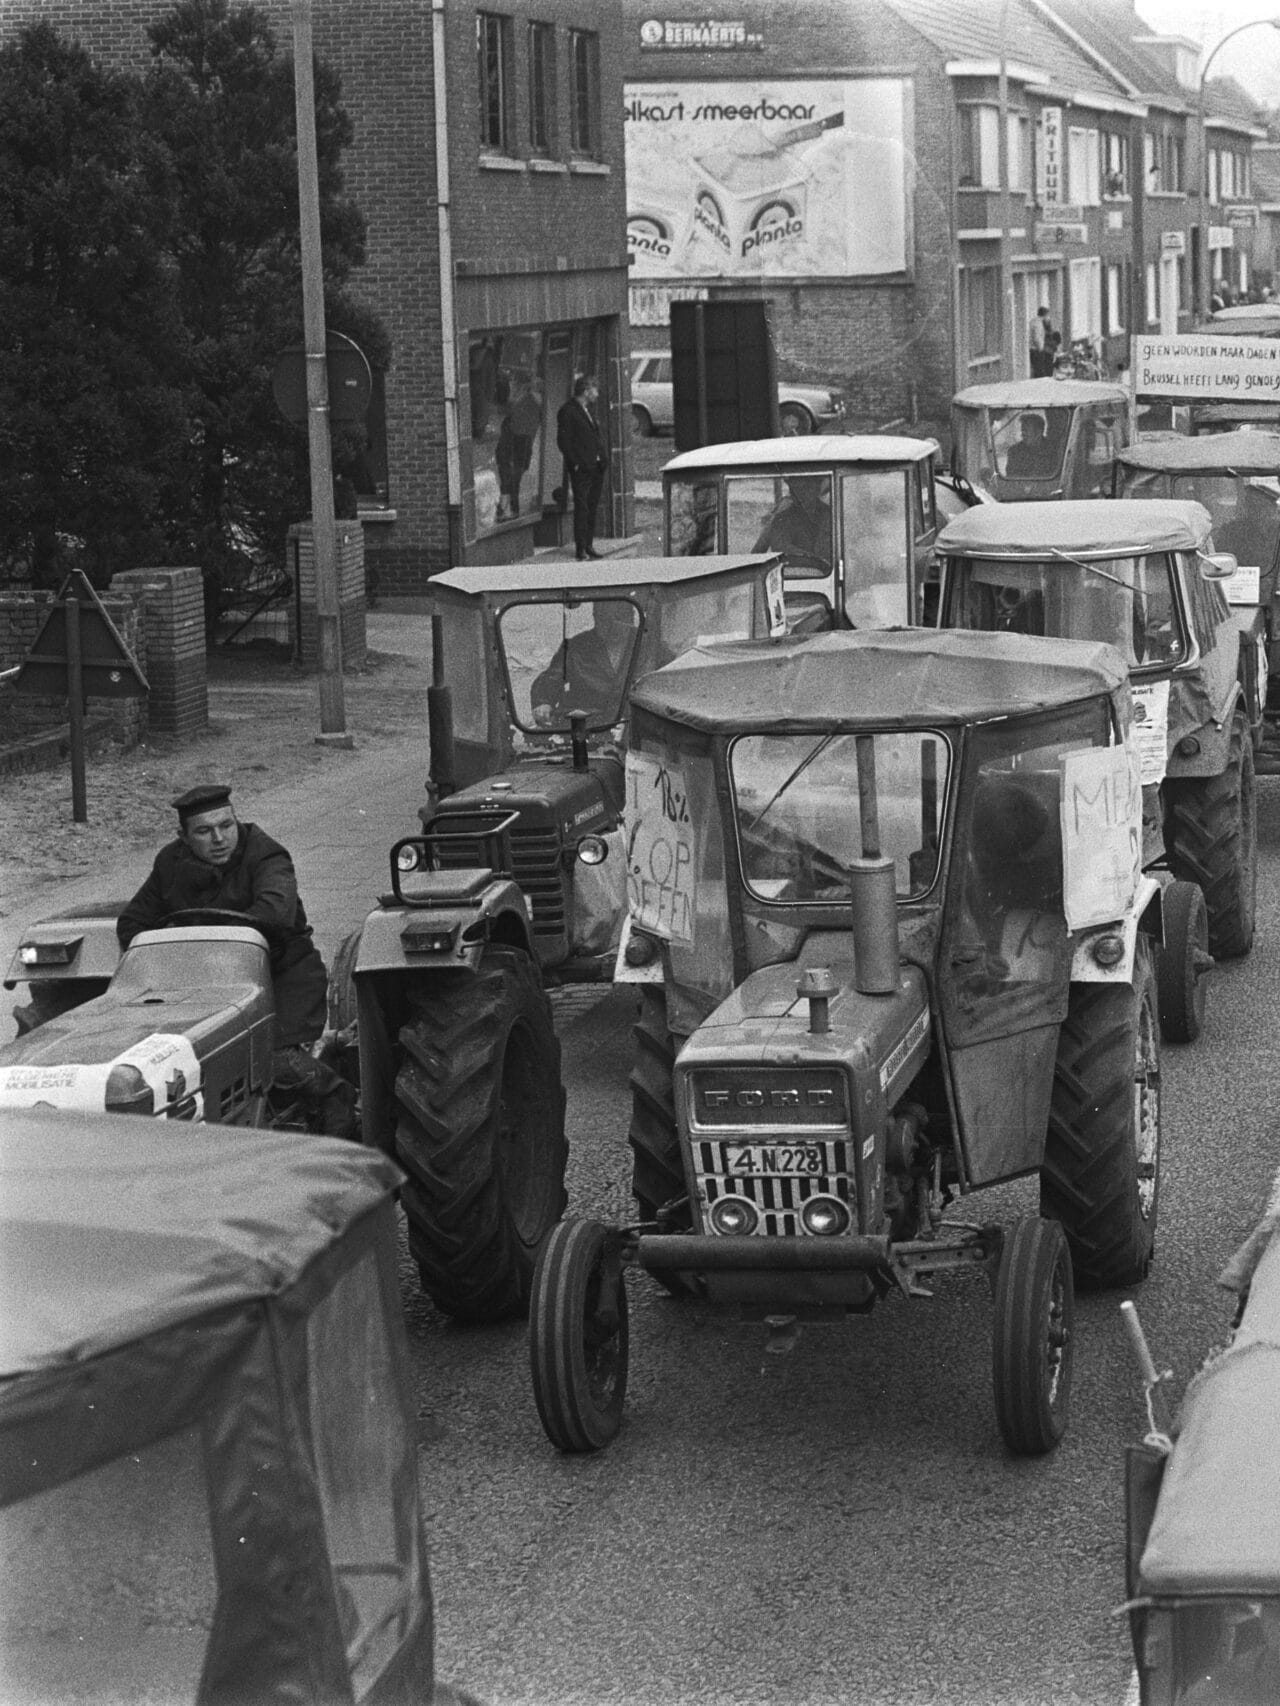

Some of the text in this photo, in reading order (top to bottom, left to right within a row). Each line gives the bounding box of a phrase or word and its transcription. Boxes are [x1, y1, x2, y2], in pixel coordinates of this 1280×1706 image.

[692, 99, 815, 121] smeerbaar
[1045, 111, 1058, 201] FRITUUR
[741, 219, 803, 257] planta
[704, 1090, 834, 1107] FORD
